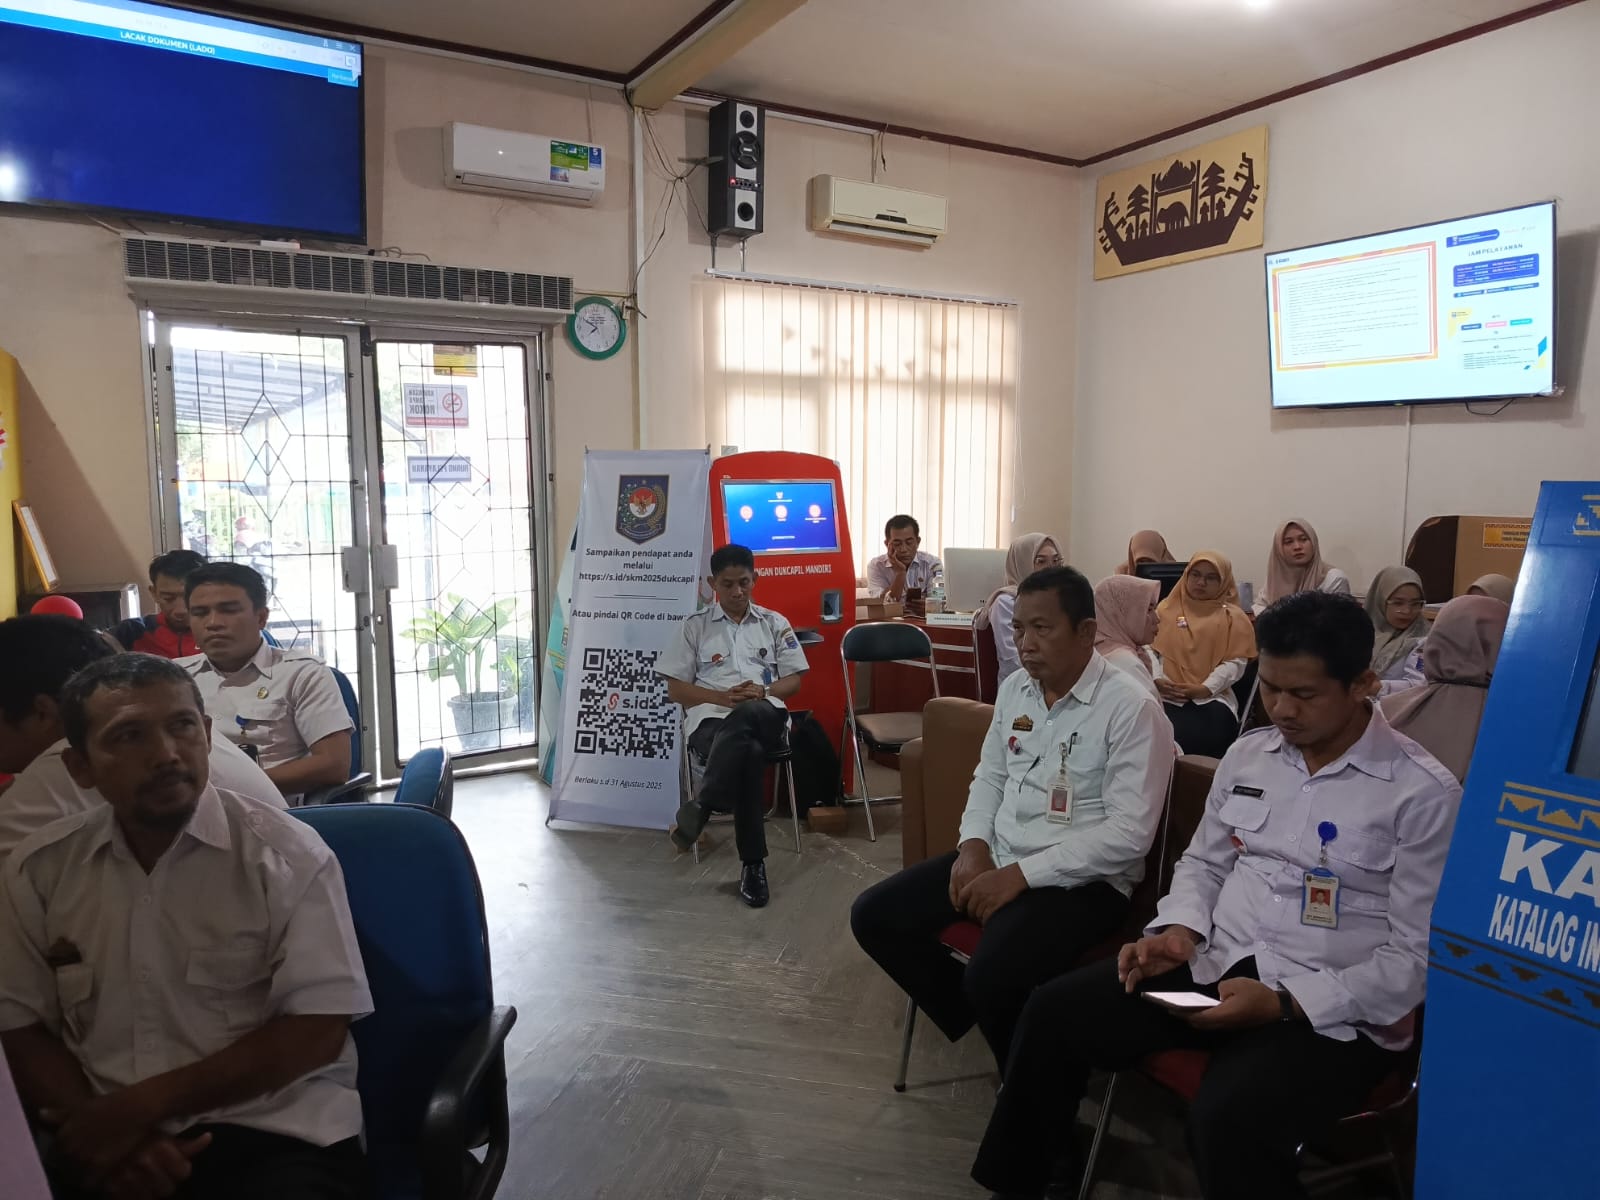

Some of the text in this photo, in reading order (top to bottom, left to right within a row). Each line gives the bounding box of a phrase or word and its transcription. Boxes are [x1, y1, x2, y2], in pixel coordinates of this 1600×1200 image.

[120, 32, 215, 54] LACAK DOKUMEN (LADO)
[586, 548, 693, 559] Sampaikan pendapat anda
[623, 561, 654, 570] melalui
[775, 566, 804, 576] DUKCAPIL
[805, 564, 832, 575] MANDIRI
[572, 609, 687, 621] Atau pindai QR Code di baw
[622, 696, 649, 709] s.id
[575, 776, 598, 785] Berlaku
[610, 778, 619, 786] 31
[619, 779, 645, 789] Agustus
[646, 780, 662, 790] 2025
[1488, 893, 1600, 974] KATALOG IN
